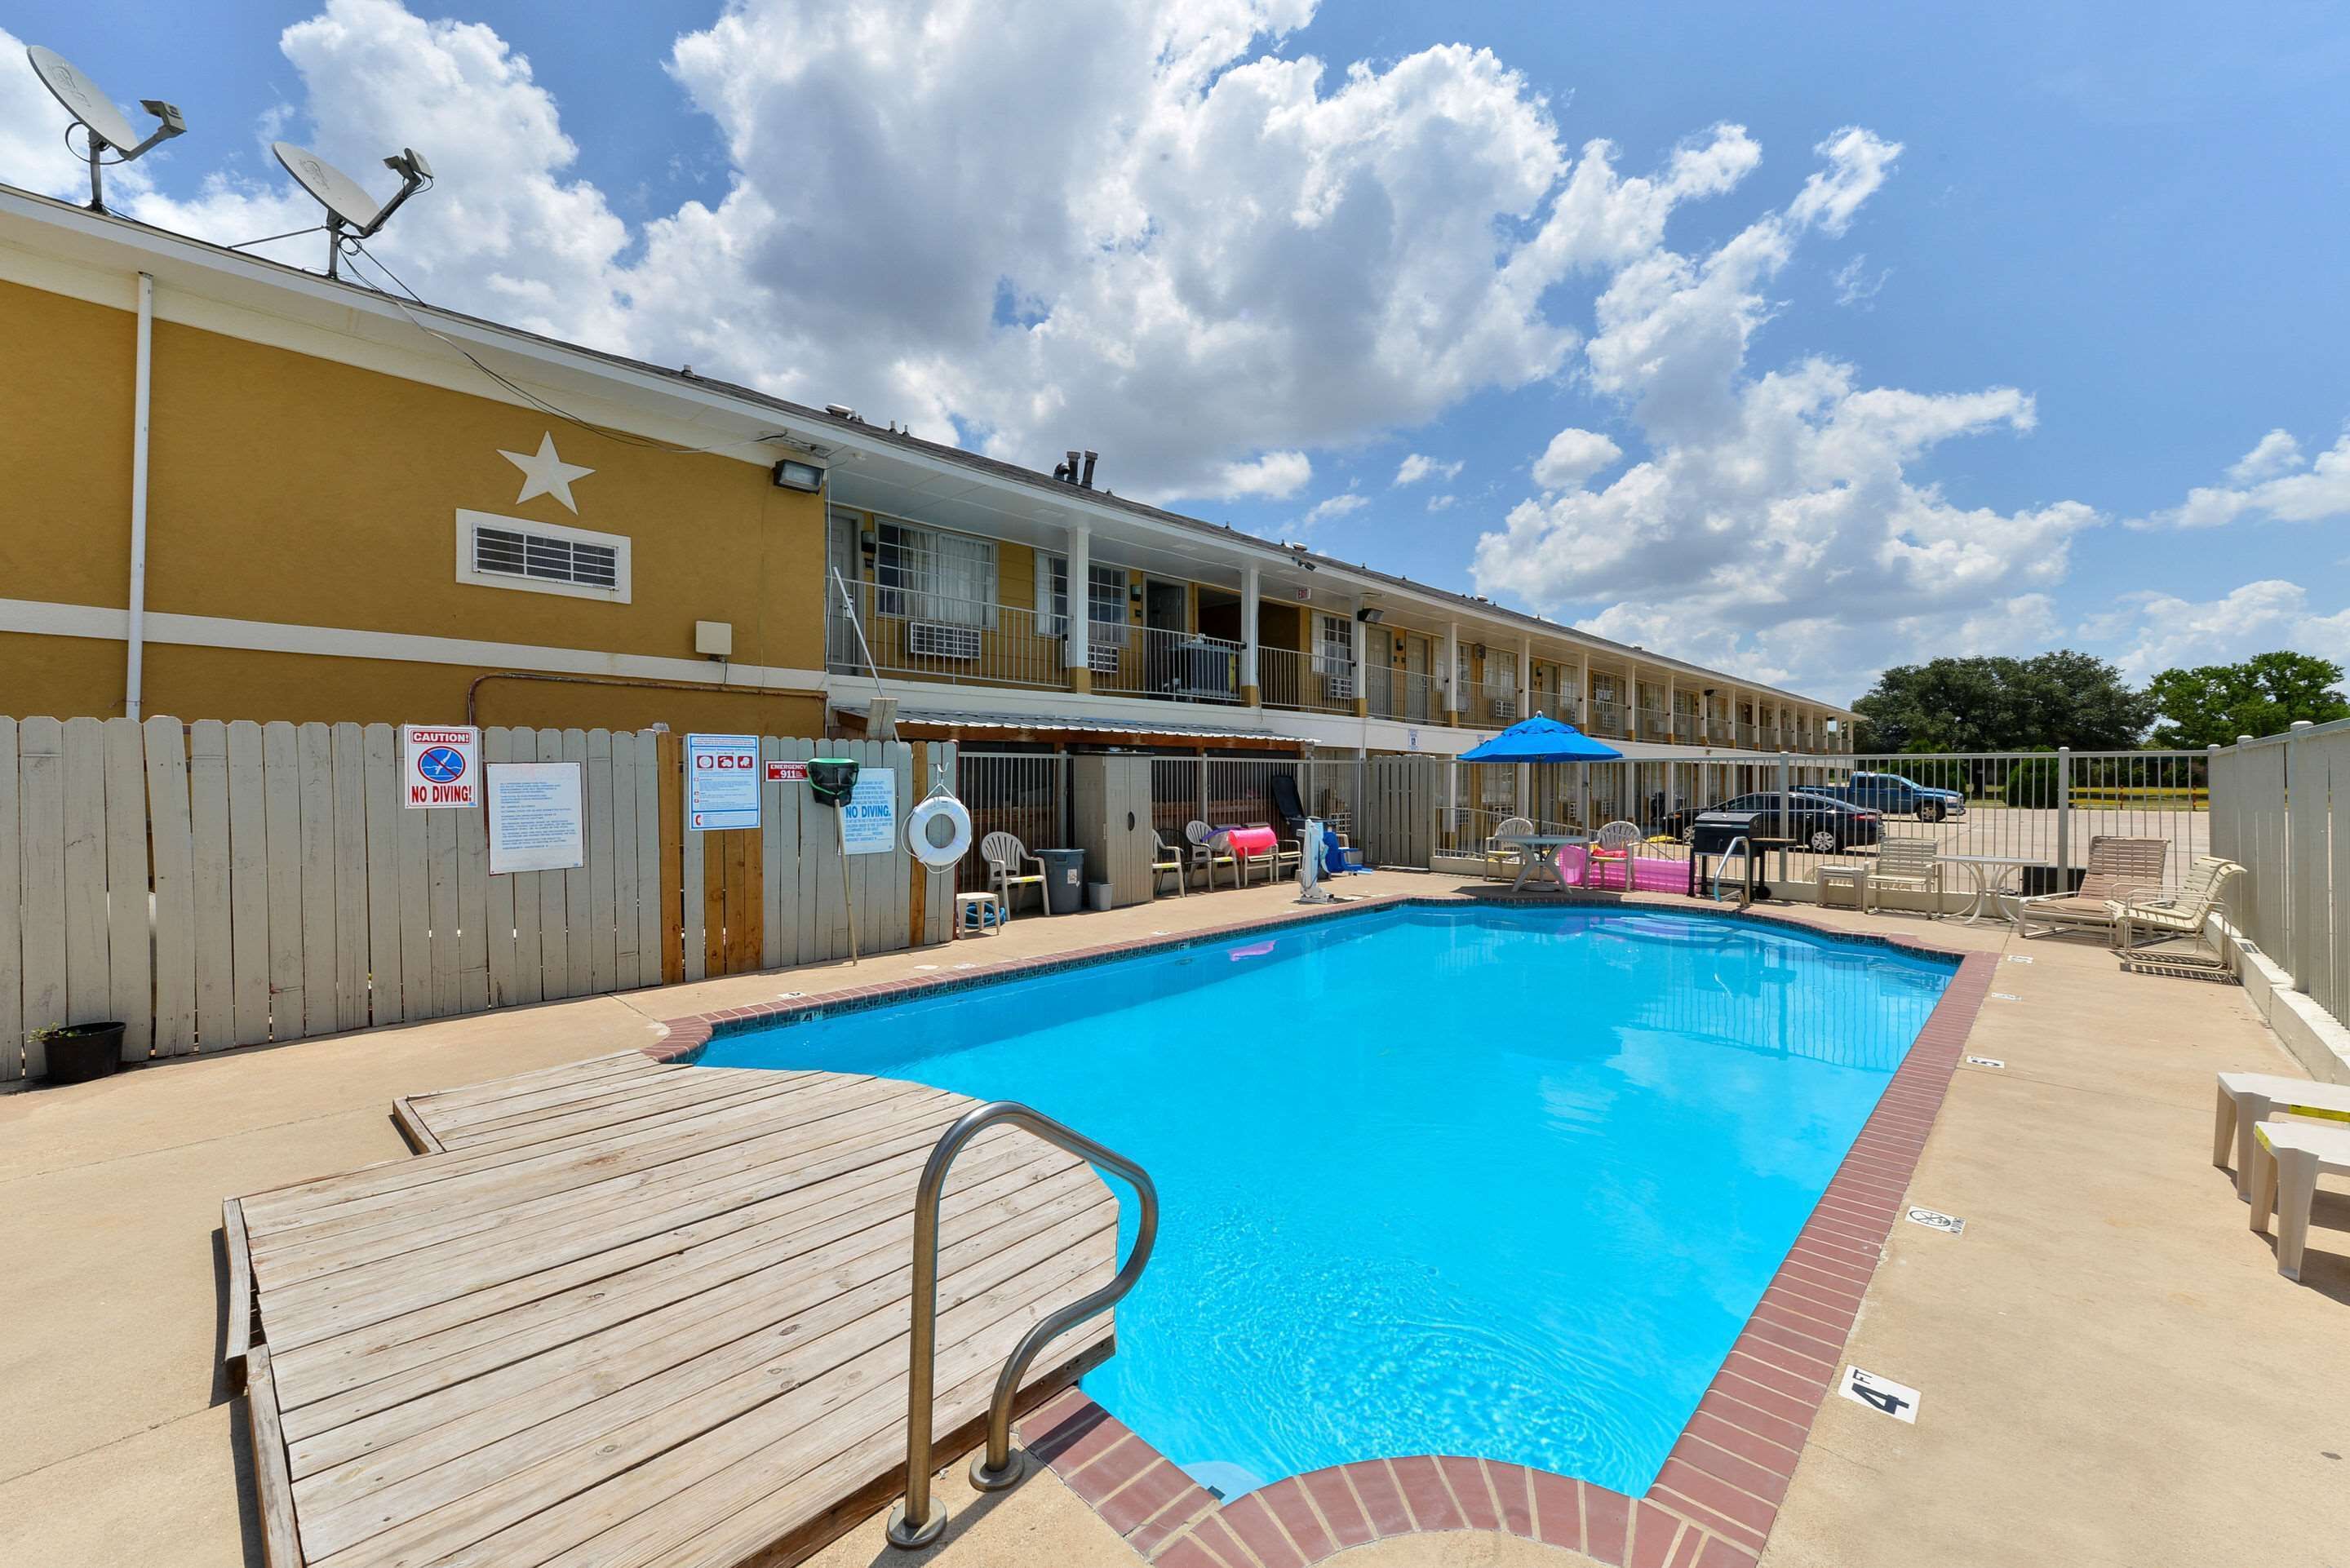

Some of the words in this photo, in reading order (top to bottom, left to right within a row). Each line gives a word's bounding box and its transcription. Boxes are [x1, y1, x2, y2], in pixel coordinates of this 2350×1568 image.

[414, 733, 469, 742] CAUTION!
[780, 769, 796, 779] 911
[411, 786, 428, 803] NO
[432, 785, 472, 803] DIVING!
[845, 806, 858, 818] NO
[862, 804, 891, 818] DIVING.
[1852, 1369, 1873, 1384] FT
[1851, 1382, 1909, 1415] 4
